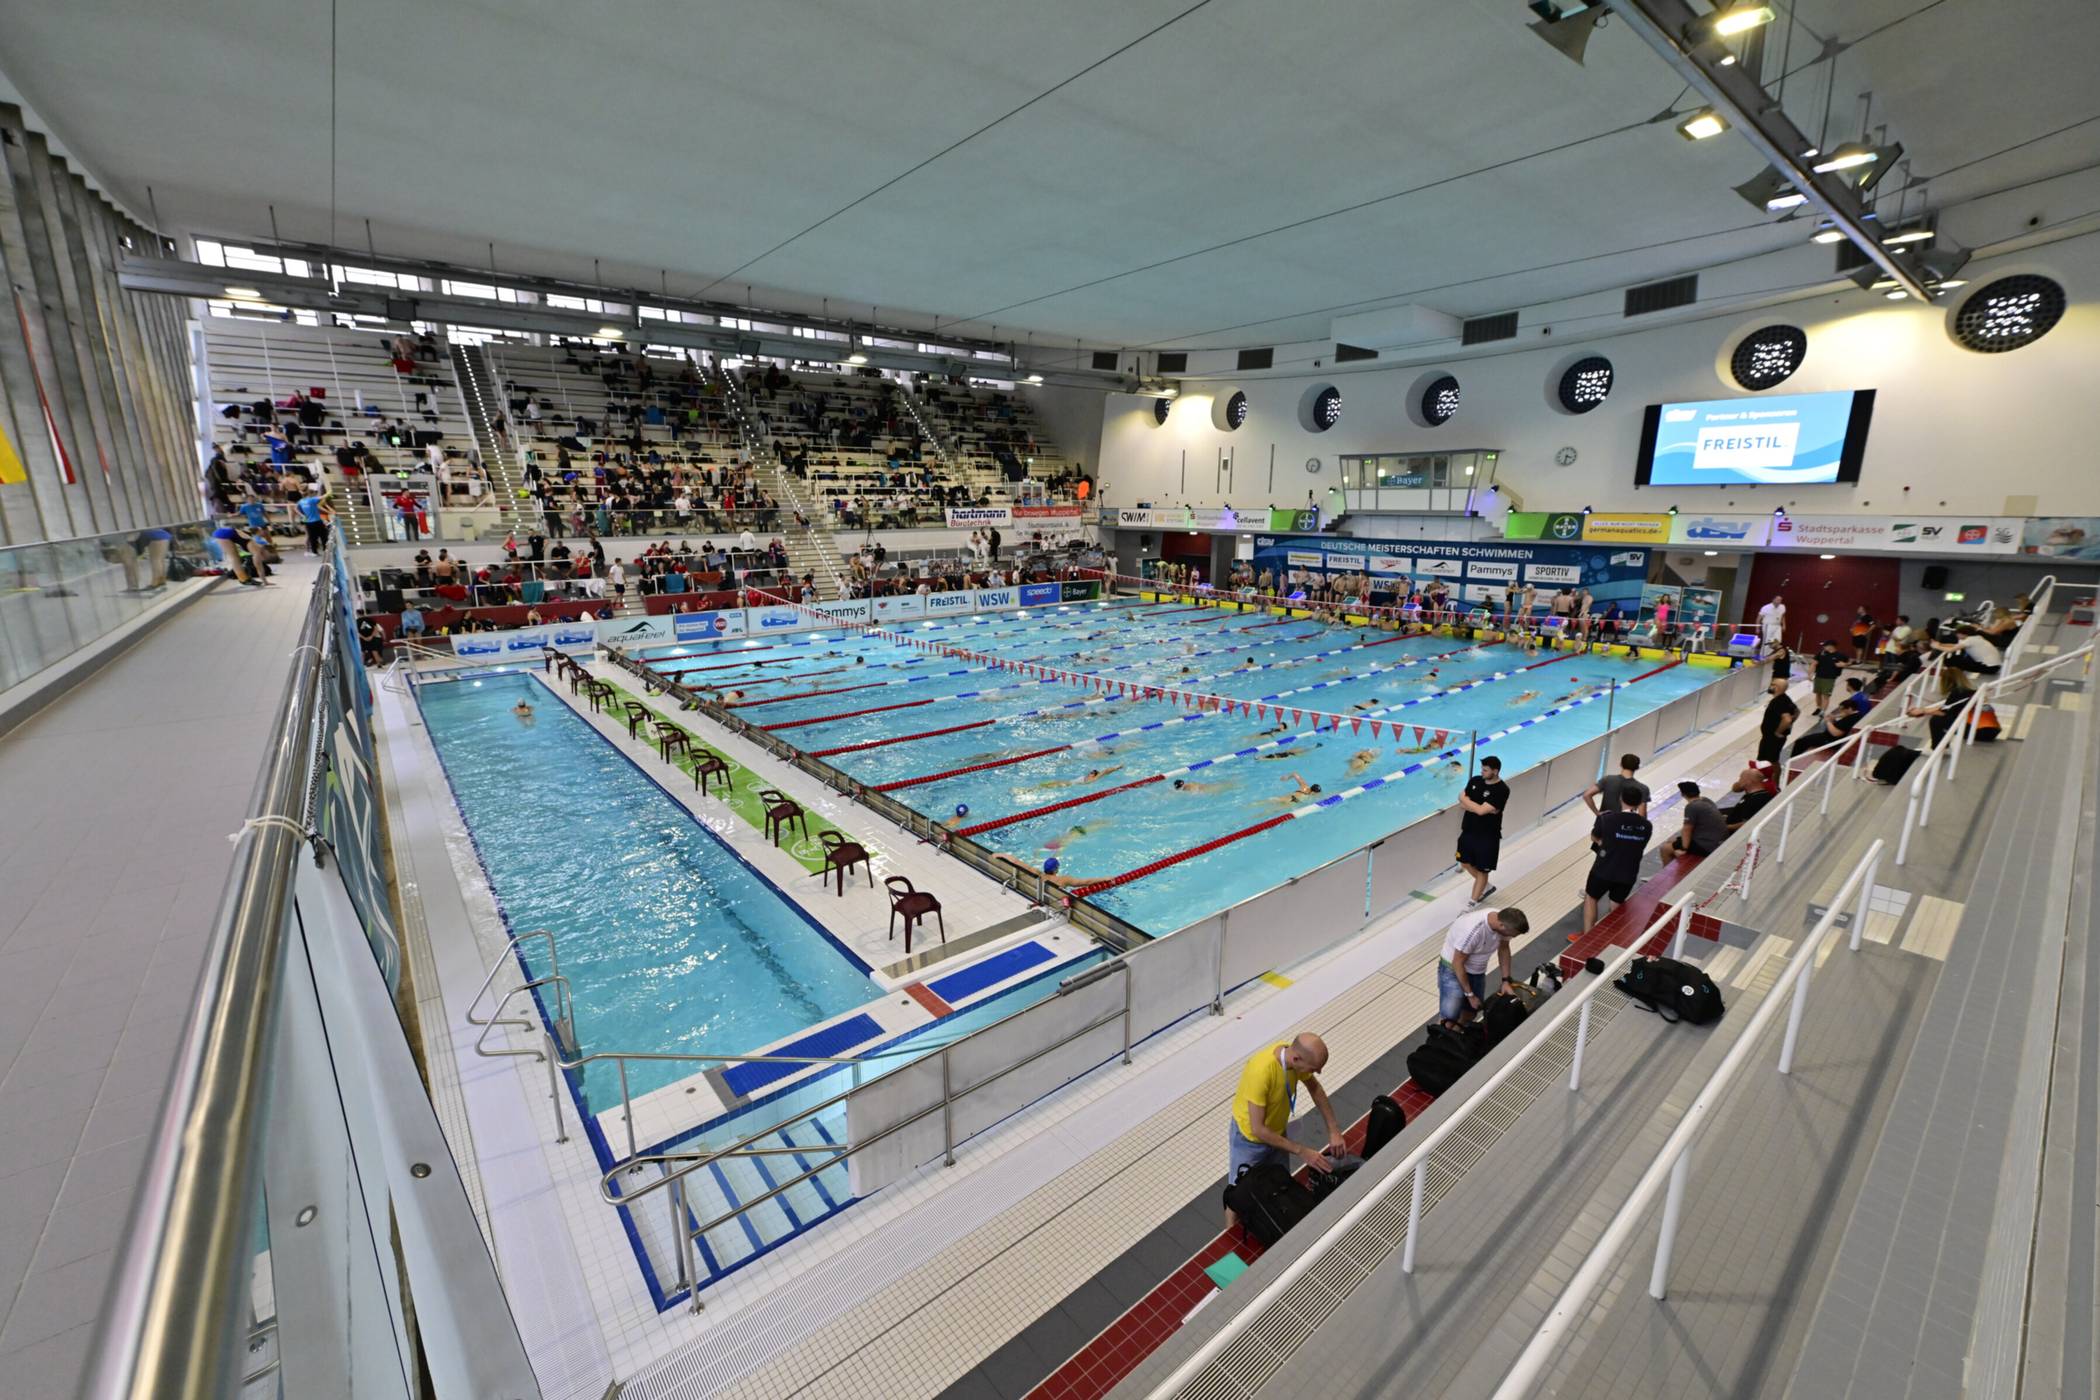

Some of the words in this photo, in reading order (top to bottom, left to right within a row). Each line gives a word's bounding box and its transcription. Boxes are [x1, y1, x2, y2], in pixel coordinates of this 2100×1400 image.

[1703, 436, 1782, 451] FREISTIL
[1396, 475, 1423, 485] Bayer
[951, 508, 1007, 520] hartmann
[950, 519, 992, 527] Bürotechnik
[1236, 516, 1265, 525] cellavent
[1797, 523, 1885, 536] Stadtsparkasse
[1921, 526, 1944, 536] SV
[1796, 535, 1855, 545] Wuppertal
[1320, 541, 1367, 552] DEUTSCHE
[1367, 543, 1460, 556] MEISTERSCHAFTEN
[1461, 547, 1534, 560] SCHWIMMEN
[1328, 555, 1361, 565] FREISTIL
[1470, 564, 1514, 577] Pammys
[1535, 566, 1570, 577] SPORTIV
[1026, 586, 1053, 597] speedo
[1072, 587, 1087, 596] Bayer
[930, 594, 968, 608] FREISTIL
[979, 591, 1010, 607] WSW
[607, 631, 666, 644] aquafeel
